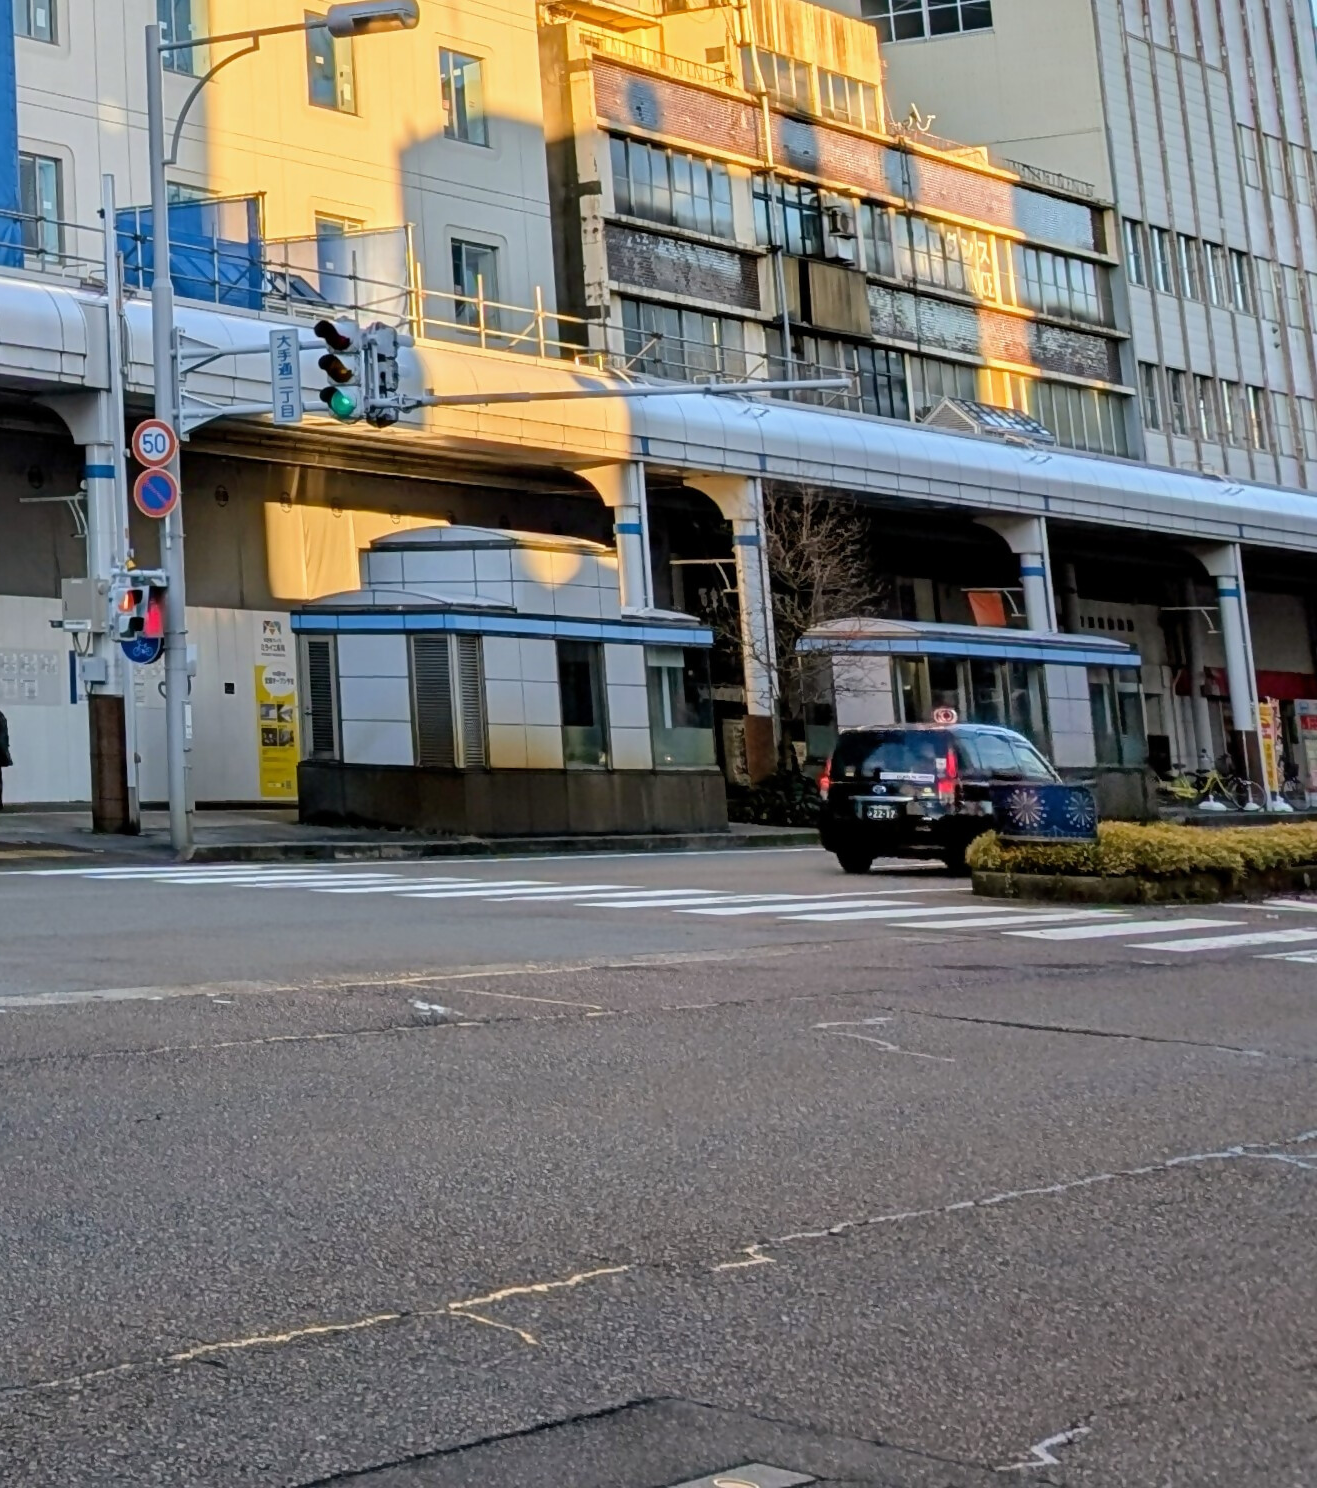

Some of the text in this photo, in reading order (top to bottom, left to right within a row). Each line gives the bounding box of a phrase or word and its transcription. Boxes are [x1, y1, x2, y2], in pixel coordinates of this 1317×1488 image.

[276, 334, 295, 418] 大手通二丁目
[142, 433, 166, 454] 50
